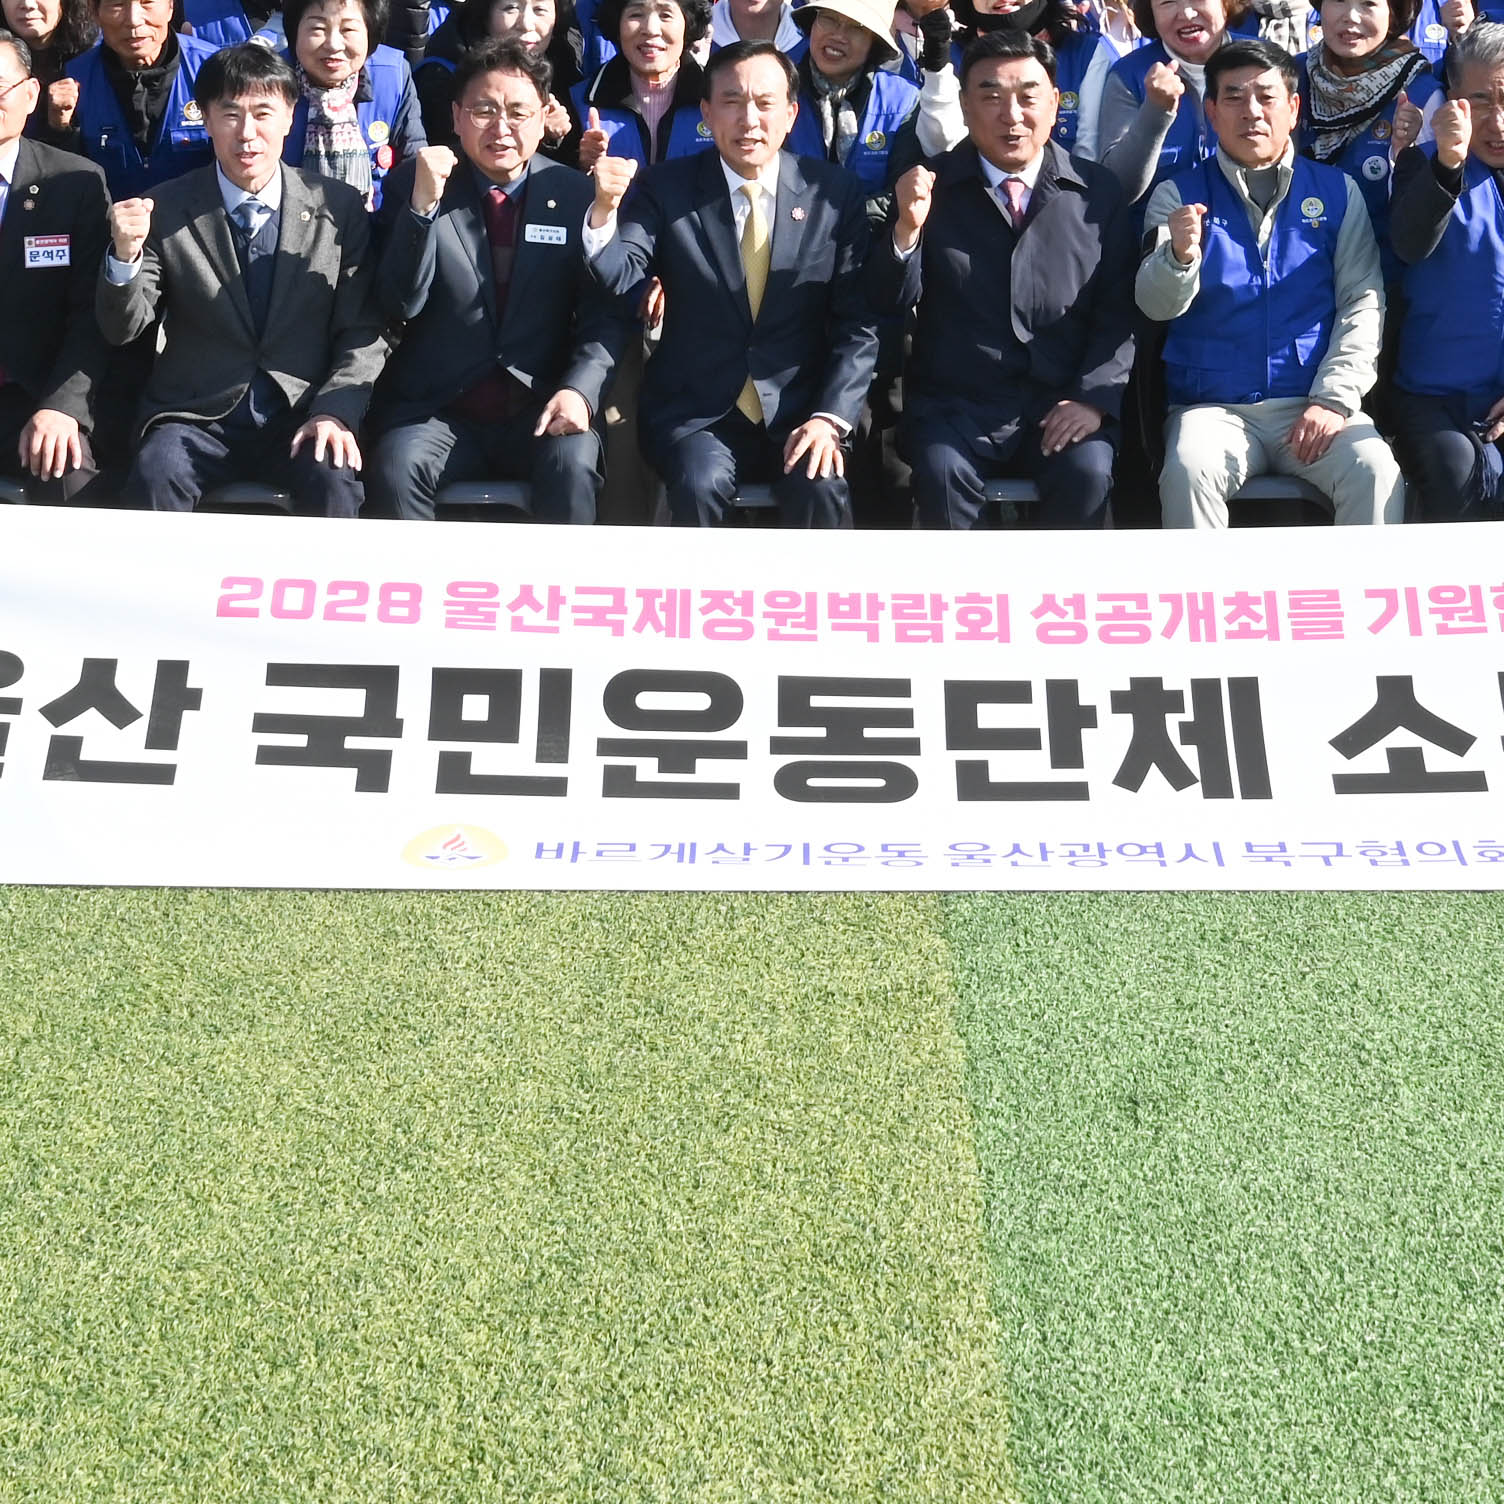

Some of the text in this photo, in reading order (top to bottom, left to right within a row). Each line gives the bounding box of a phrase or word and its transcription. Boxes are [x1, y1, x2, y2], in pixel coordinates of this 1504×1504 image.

[29, 249, 67, 263] 문석주
[216, 576, 424, 625] 2028
[443, 580, 1012, 644] 울산국제정원박람회
[1031, 587, 1346, 644] 성공개최를
[251, 662, 1274, 803] 국민운동단체
[534, 840, 929, 868] 바르게살기운동
[944, 841, 1226, 868] 울산광역시
